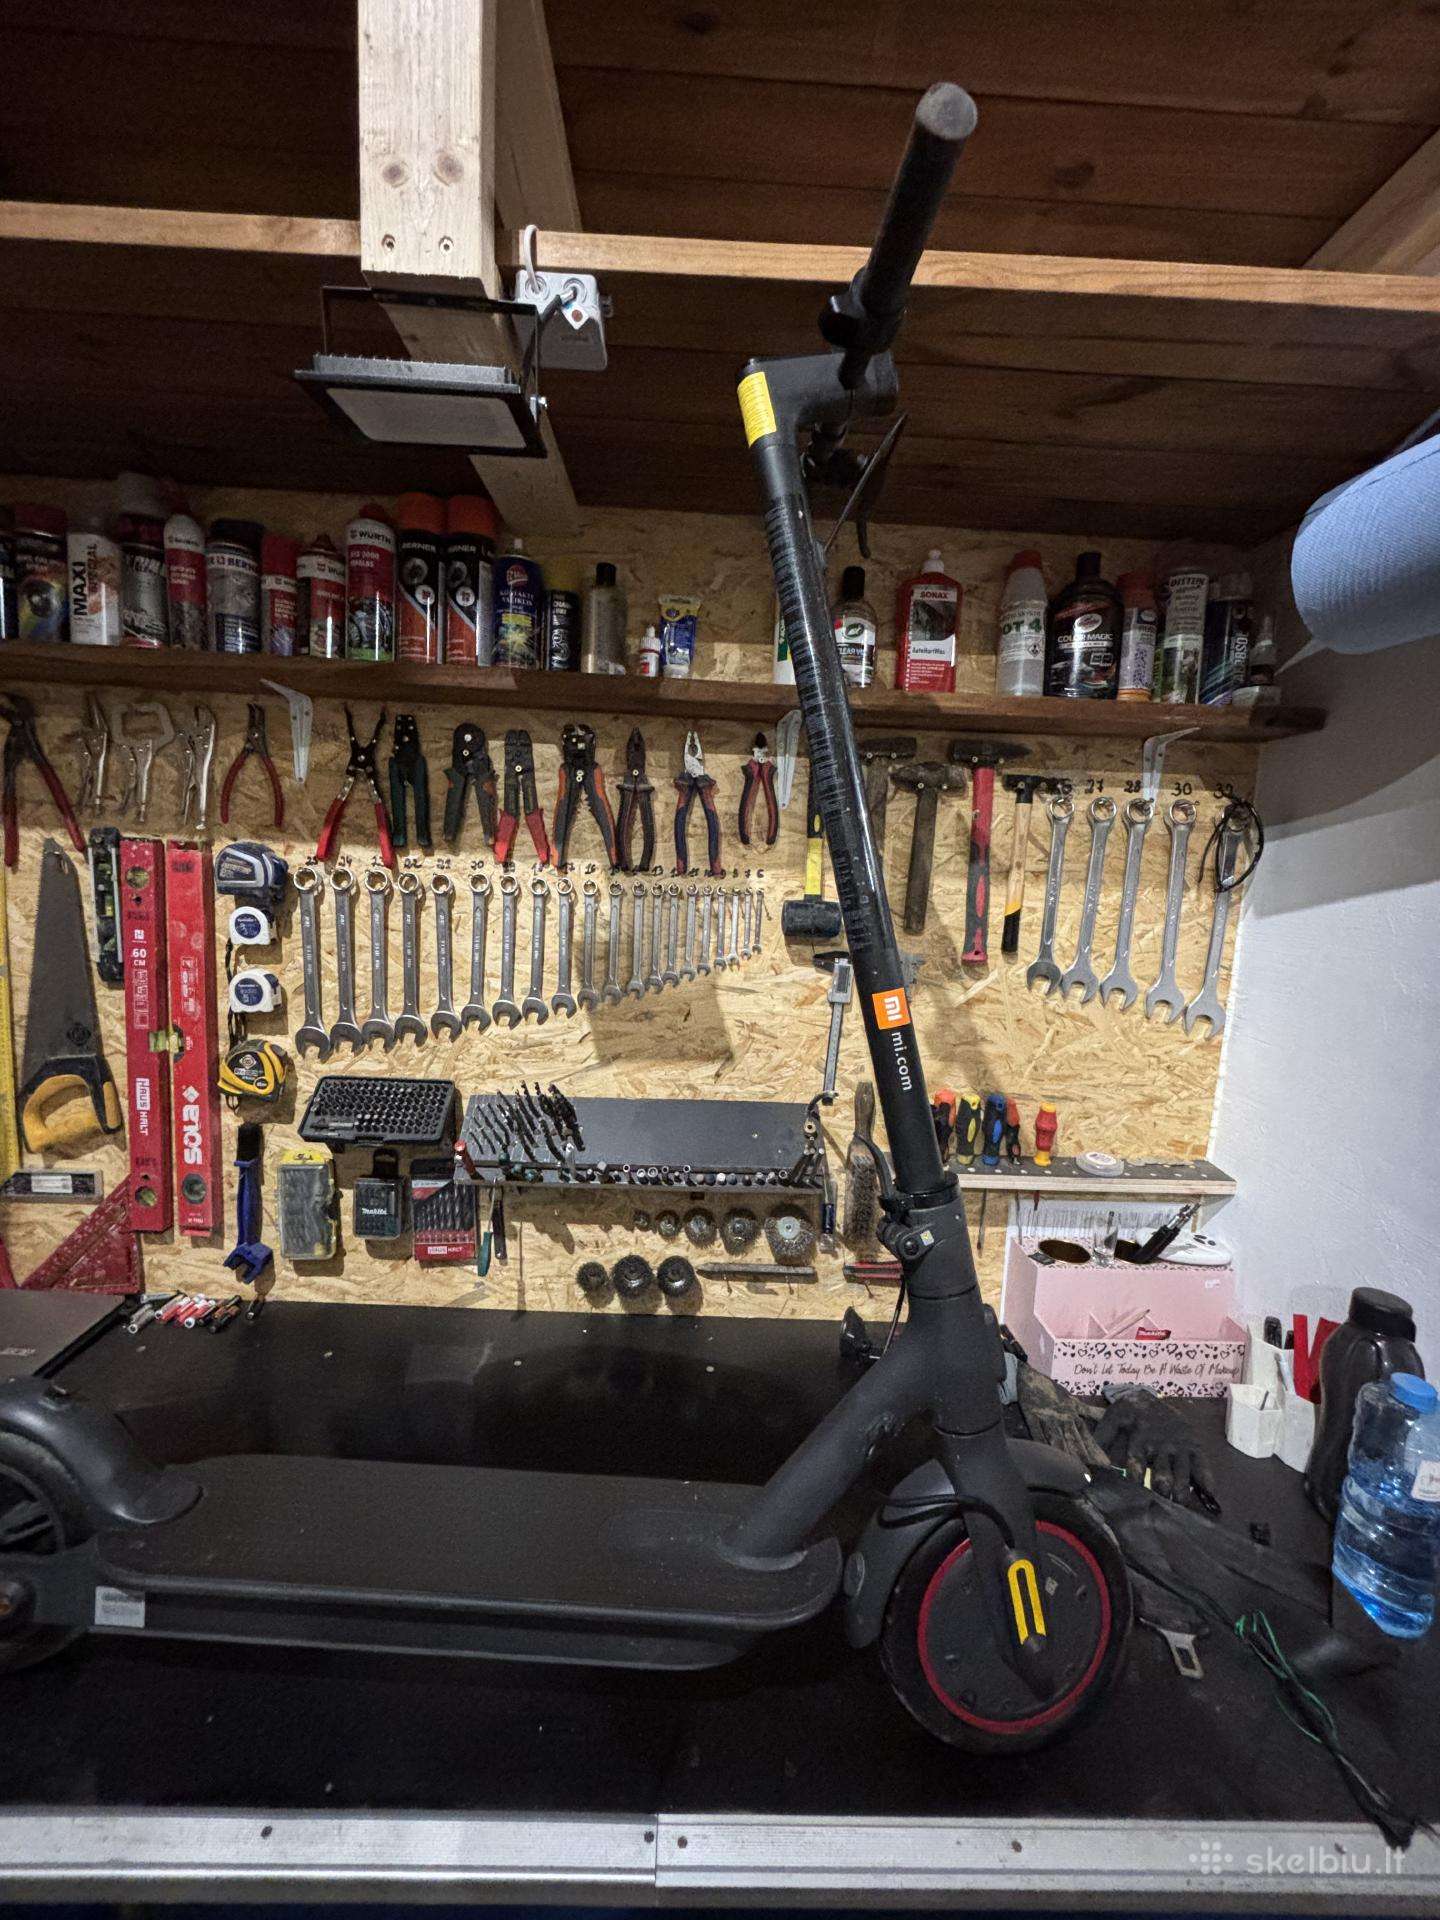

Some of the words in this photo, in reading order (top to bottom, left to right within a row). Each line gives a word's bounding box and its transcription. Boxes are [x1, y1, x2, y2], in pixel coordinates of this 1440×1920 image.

[73, 562, 87, 616] MAXI
[920, 591, 948, 599] SONAX
[1003, 620, 1025, 635] OT
[1029, 617, 1042, 633] 4
[1057, 634, 1086, 643] COLR
[1123, 780, 1141, 793] 28
[1171, 782, 1192, 797] 30
[404, 858, 422, 869] 22
[470, 860, 485, 871] 20
[585, 863, 597, 875] 16
[756, 869, 765, 879] 6
[132, 948, 147, 959] 60
[133, 959, 146, 967] CM
[891, 1031, 913, 1091] mi.com
[182, 1104, 203, 1165] SOLA
[1101, 1363, 1114, 1375] Let
[1118, 1364, 1140, 1381] Today
[1143, 1363, 1156, 1375] Be
[1169, 1364, 1193, 1375] Waste
[1208, 1364, 1240, 1378] Makeup
